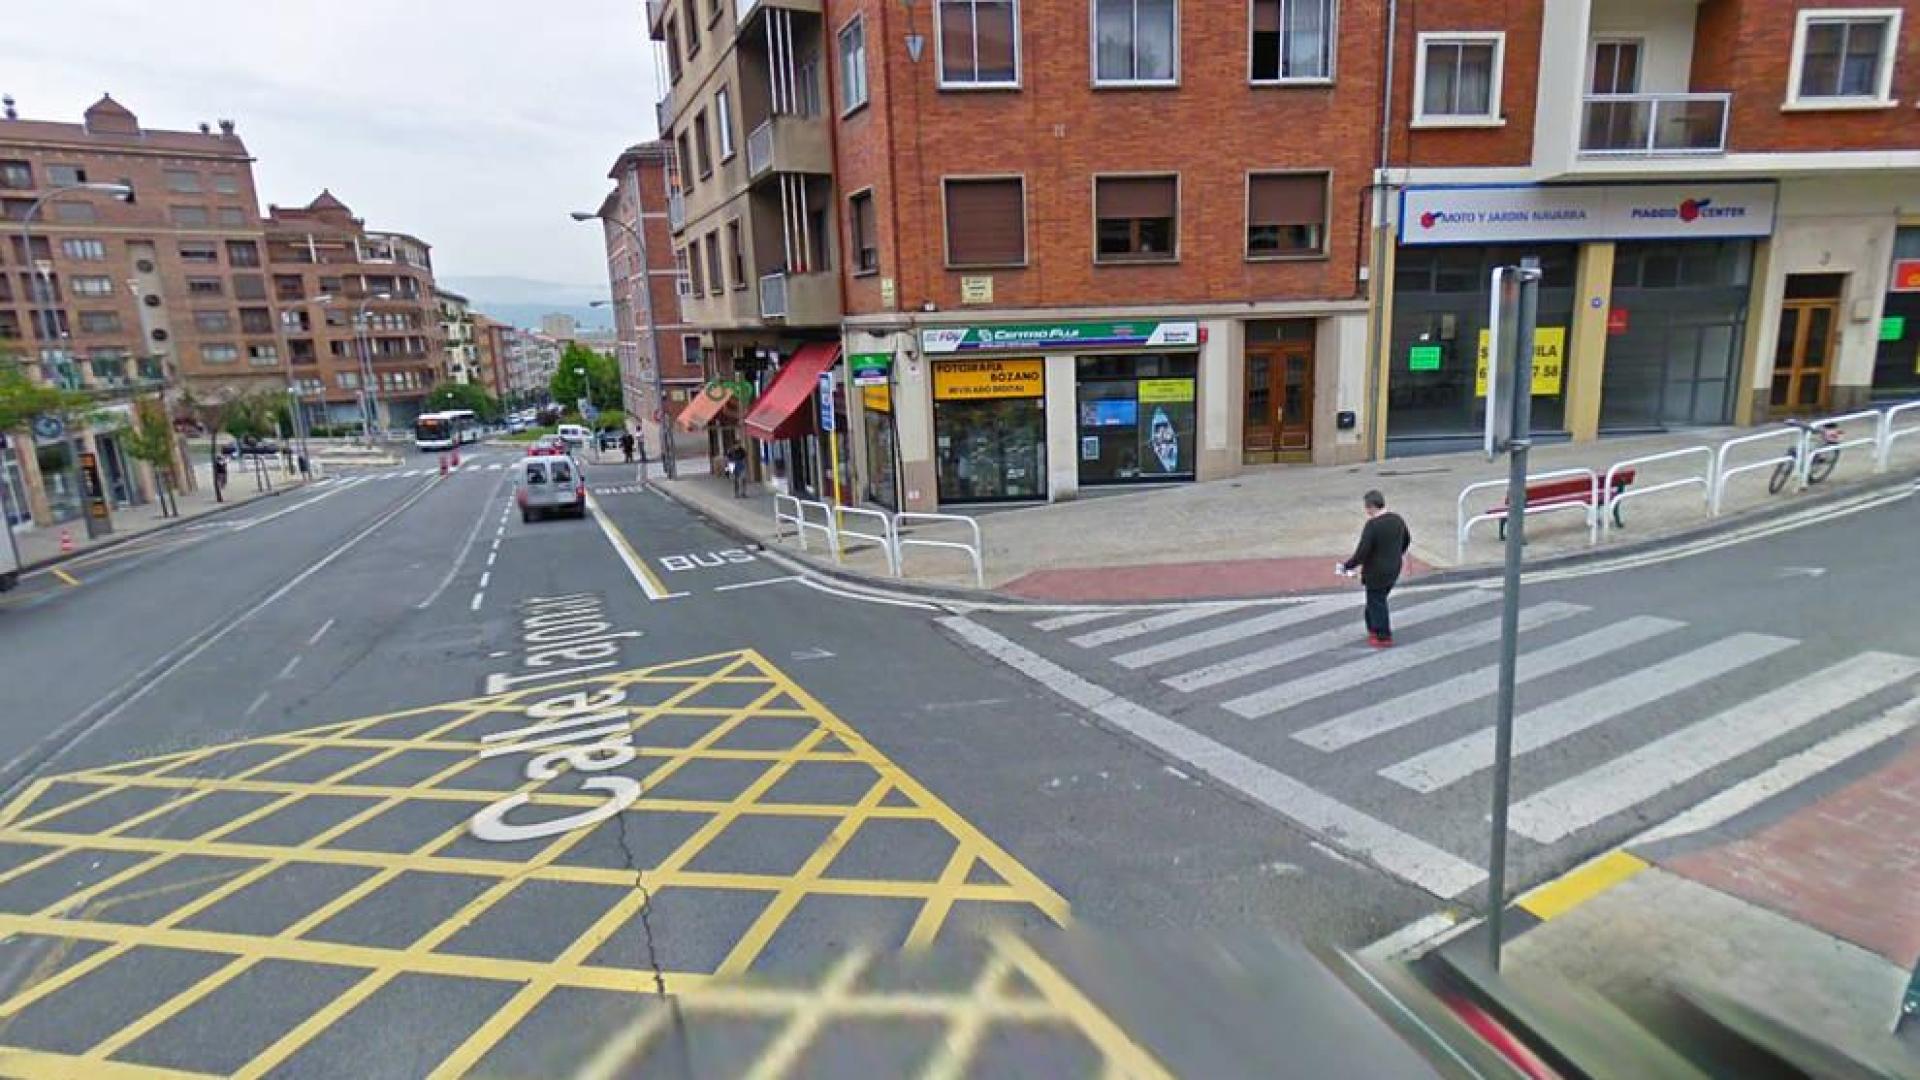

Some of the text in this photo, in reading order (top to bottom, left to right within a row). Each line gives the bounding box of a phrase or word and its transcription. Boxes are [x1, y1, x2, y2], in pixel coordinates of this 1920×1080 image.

[1701, 205, 1746, 219] CENTER
[990, 370, 1040, 383] BOZANO
[660, 549, 756, 571] BUS
